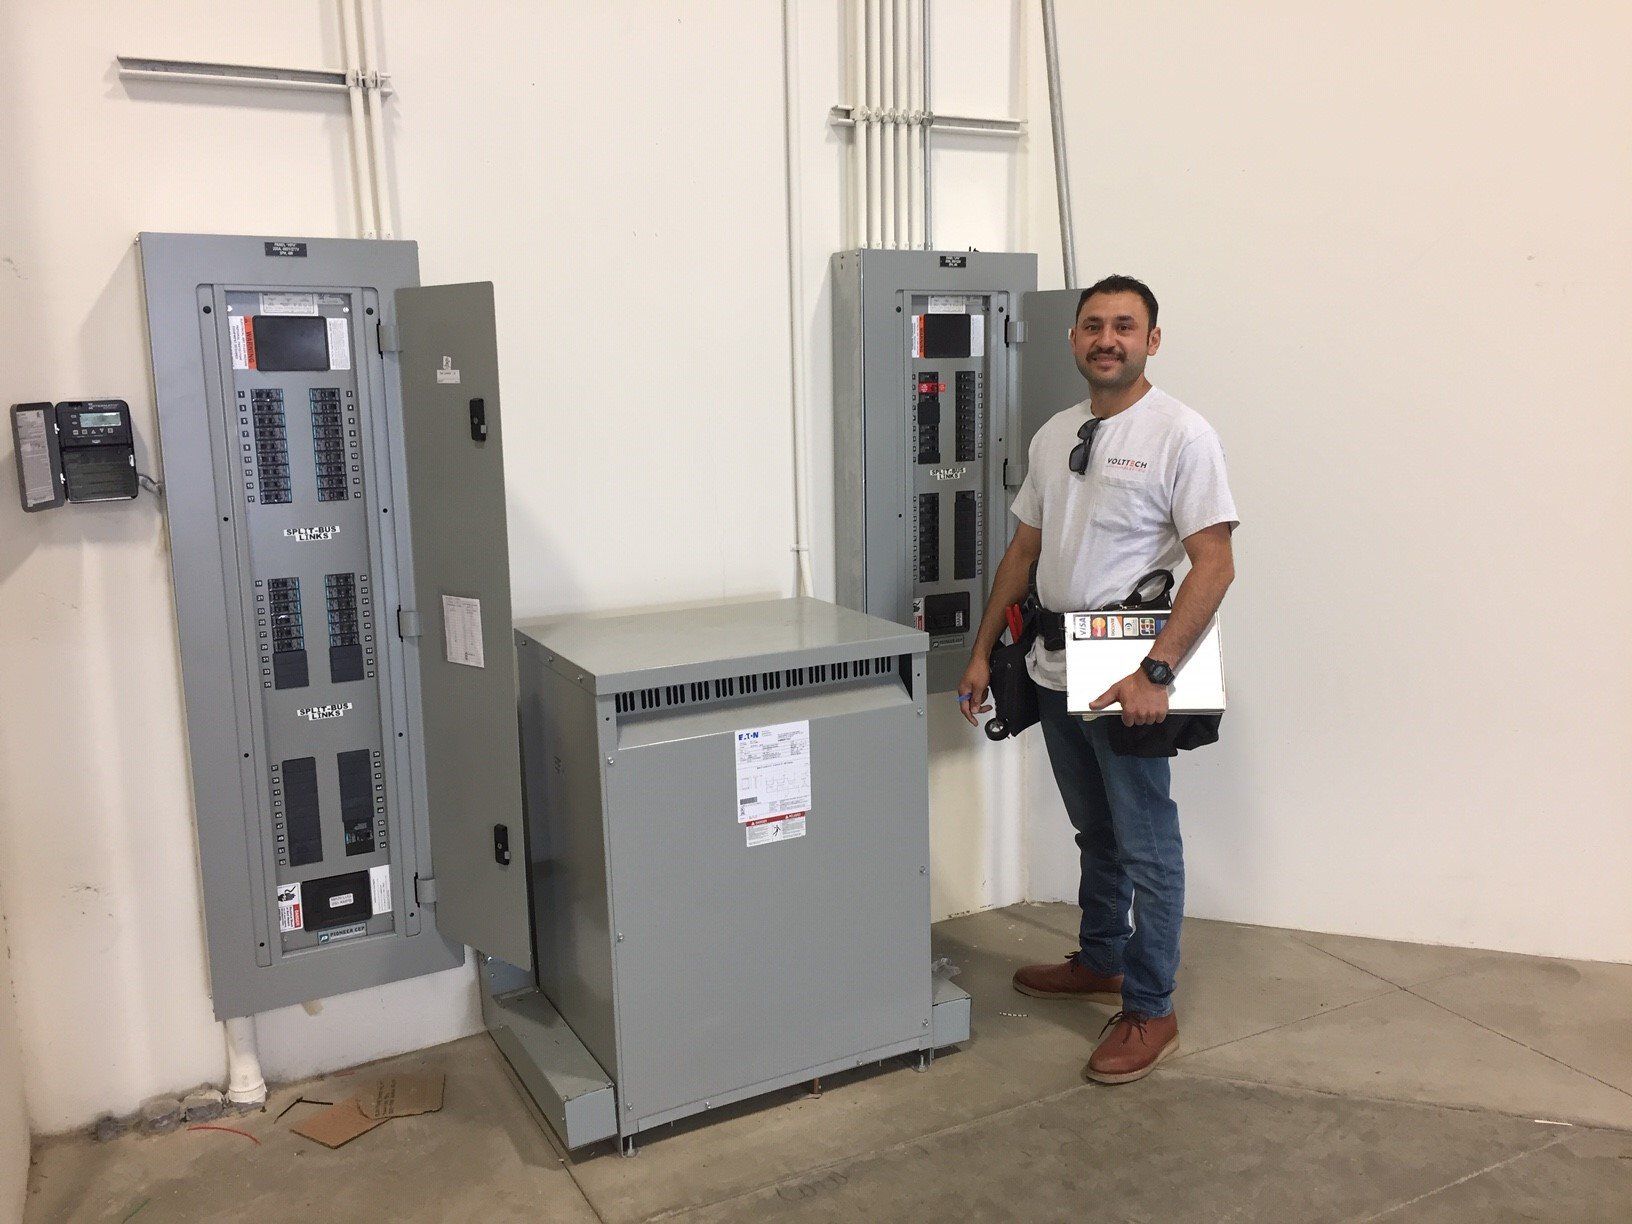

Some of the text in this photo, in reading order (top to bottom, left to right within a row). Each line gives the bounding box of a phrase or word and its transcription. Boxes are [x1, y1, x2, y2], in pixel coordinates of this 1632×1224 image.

[245, 330, 254, 363] WARNING
[1107, 457, 1148, 468] VOLTTECH
[286, 526, 337, 536] SPLIT-BUS
[299, 533, 329, 541] LINKS
[1079, 617, 1087, 636] VISA
[299, 703, 349, 715] SPLIT-BUS
[312, 710, 341, 720] LINKS
